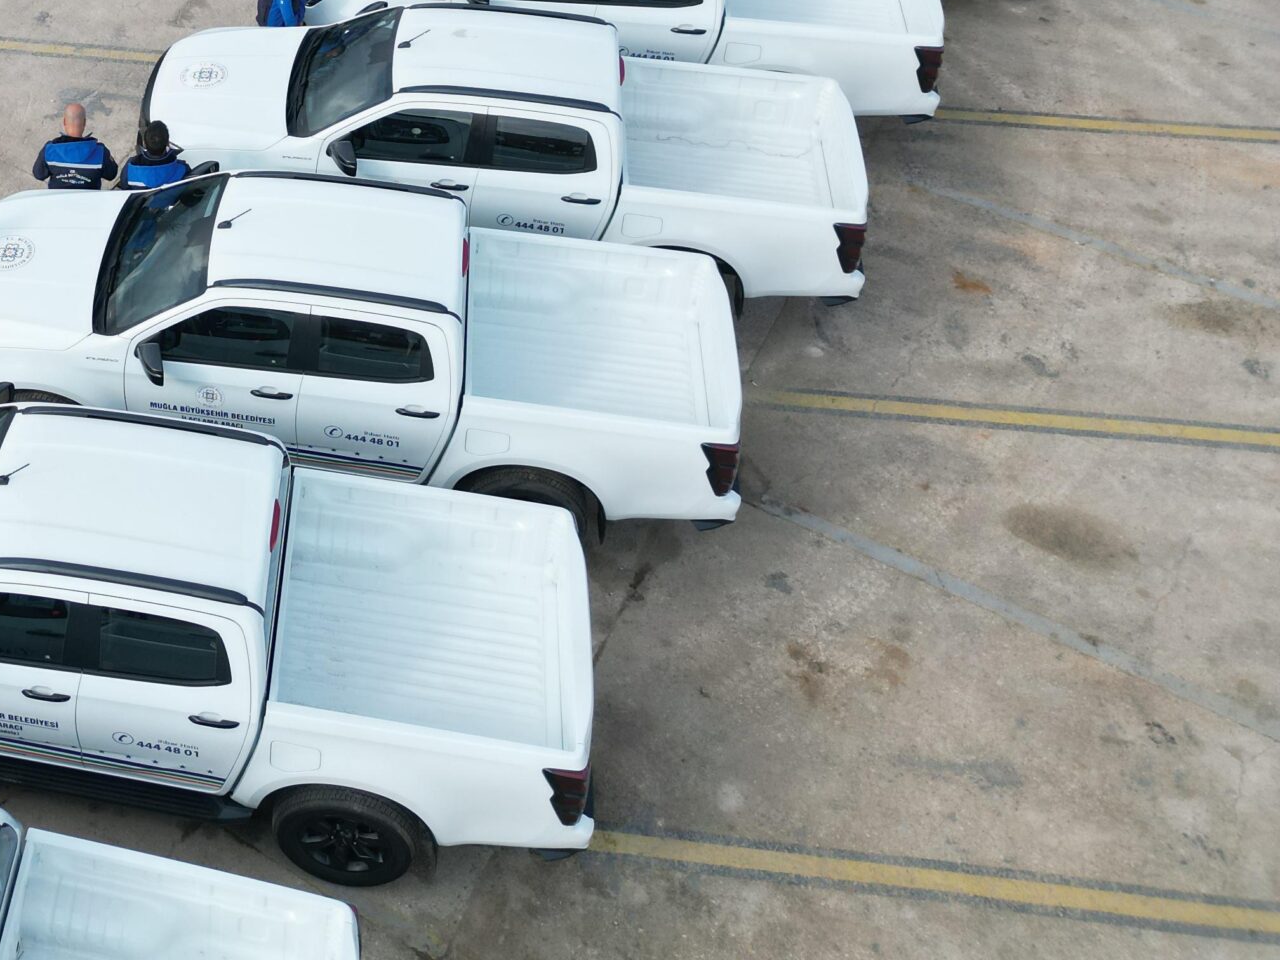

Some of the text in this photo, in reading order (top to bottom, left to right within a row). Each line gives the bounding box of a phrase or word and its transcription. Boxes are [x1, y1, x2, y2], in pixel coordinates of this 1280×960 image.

[515, 221, 565, 234] 444 48 01
[150, 401, 178, 411] MUĞLA
[231, 412, 276, 425] BELEDİYESİ
[344, 433, 400, 448] 444 48 01
[8, 714, 59, 728] BELEDİYESİ
[136, 741, 199, 758] 444 48 01
